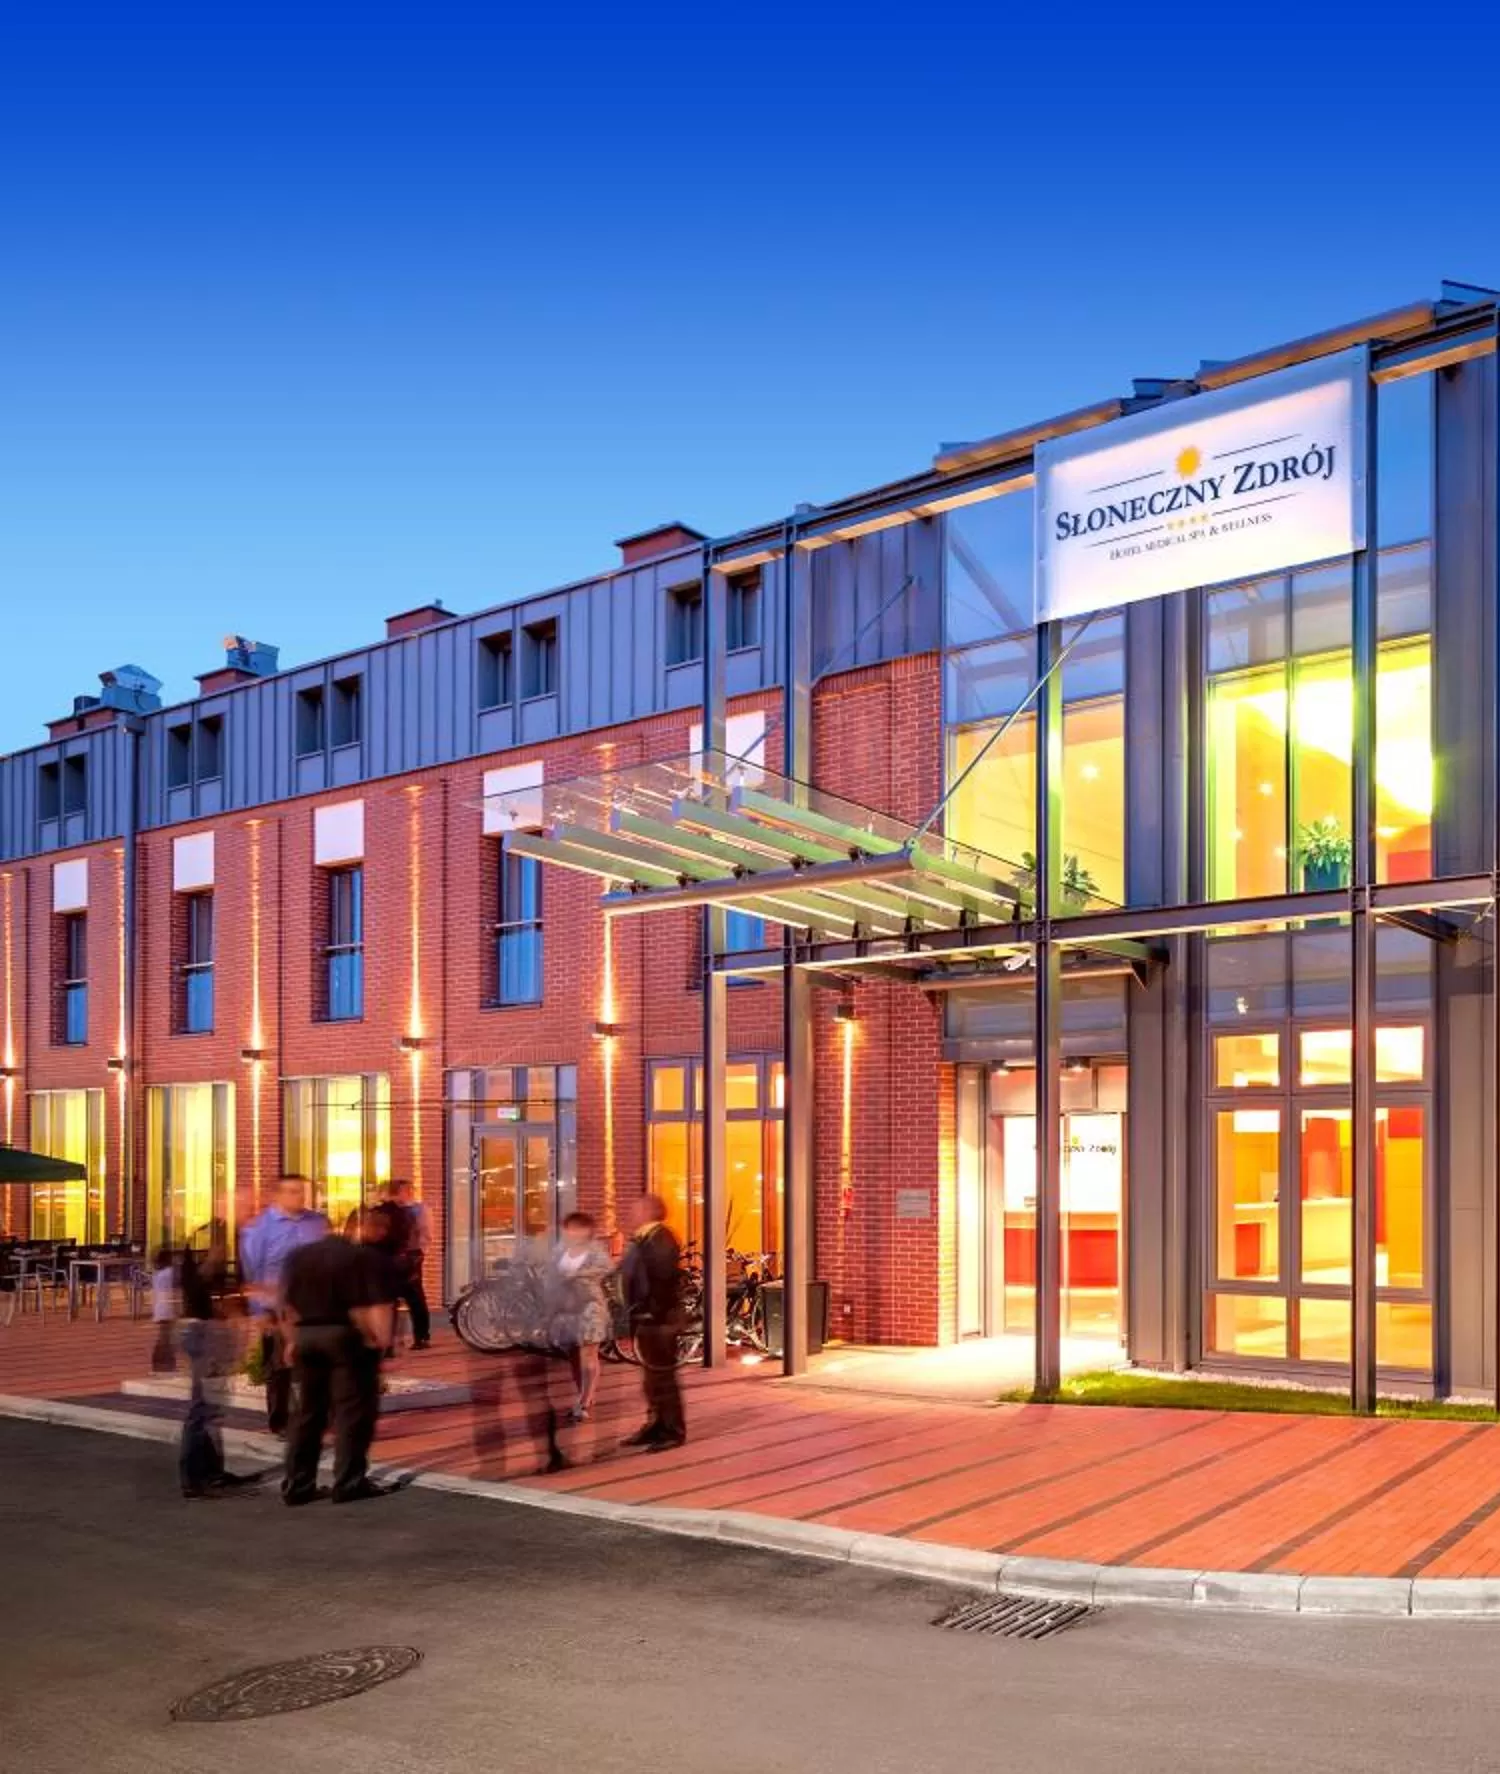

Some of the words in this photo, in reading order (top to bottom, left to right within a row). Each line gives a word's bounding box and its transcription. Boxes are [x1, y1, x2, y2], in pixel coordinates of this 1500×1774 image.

[1056, 474, 1226, 541] SŁONECZNY
[1233, 443, 1337, 495] ZDRÓJ
[1209, 525, 1219, 536] &
